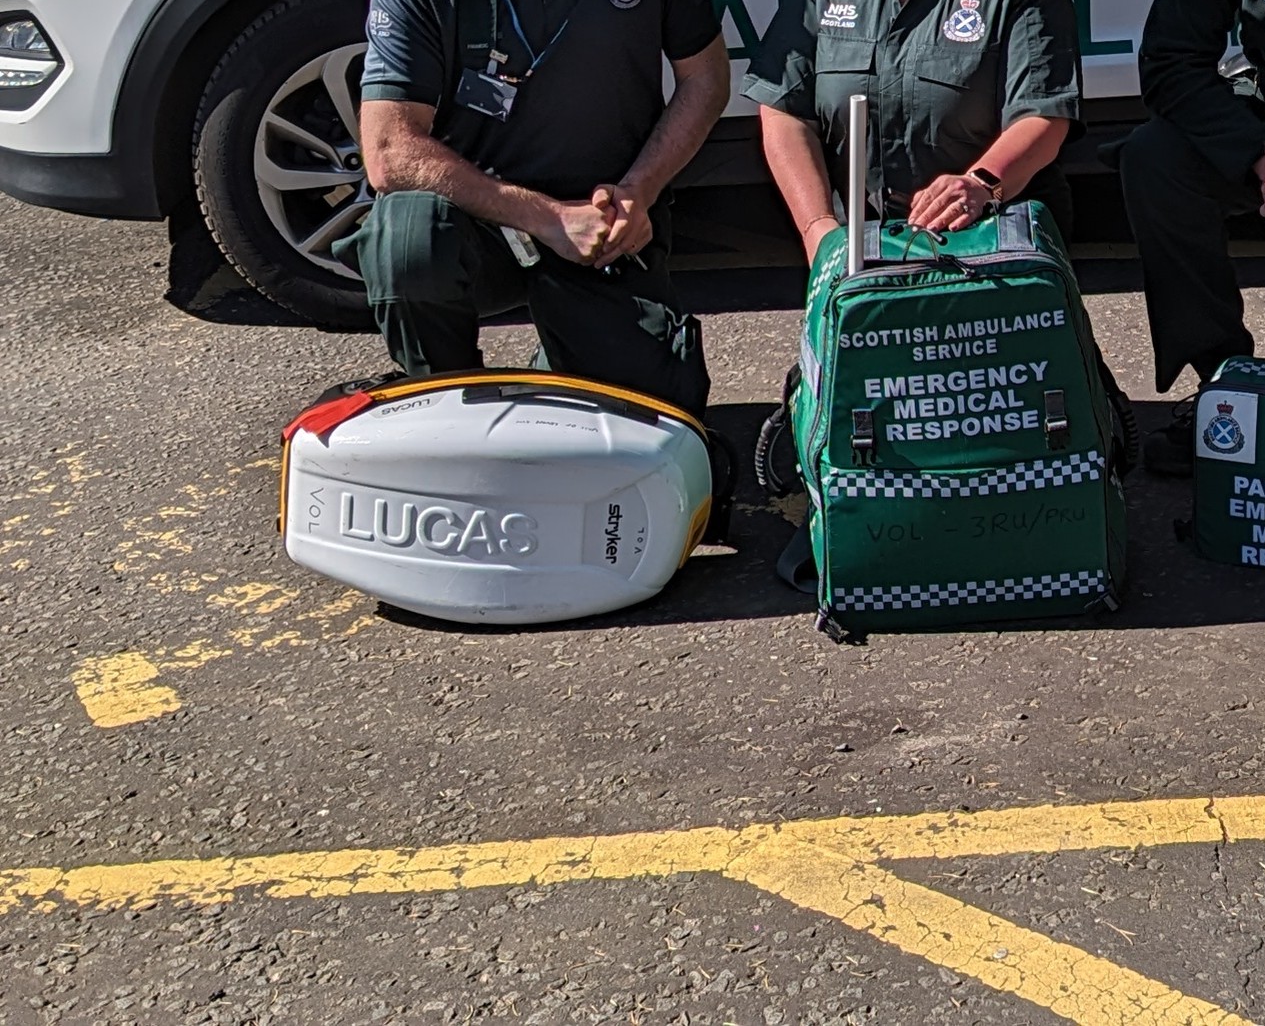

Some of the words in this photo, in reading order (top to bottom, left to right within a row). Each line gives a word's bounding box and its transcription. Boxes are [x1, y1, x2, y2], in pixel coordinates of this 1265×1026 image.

[821, 19, 855, 28] SCOTLAND
[828, 3, 856, 15] NHS
[839, 325, 939, 349] SCOTTISH
[944, 310, 1066, 340] AMBULANCE
[912, 339, 998, 362] SERVICE
[864, 361, 1049, 399] EMERGENCY
[381, 399, 431, 415] LUCAS
[893, 389, 1025, 420] MEDICAL
[886, 410, 1039, 442] RESPONSE
[308, 487, 325, 534] VOL
[340, 492, 538, 557] LUCAS
[604, 503, 623, 564] stryker
[867, 524, 922, 543] VOL
